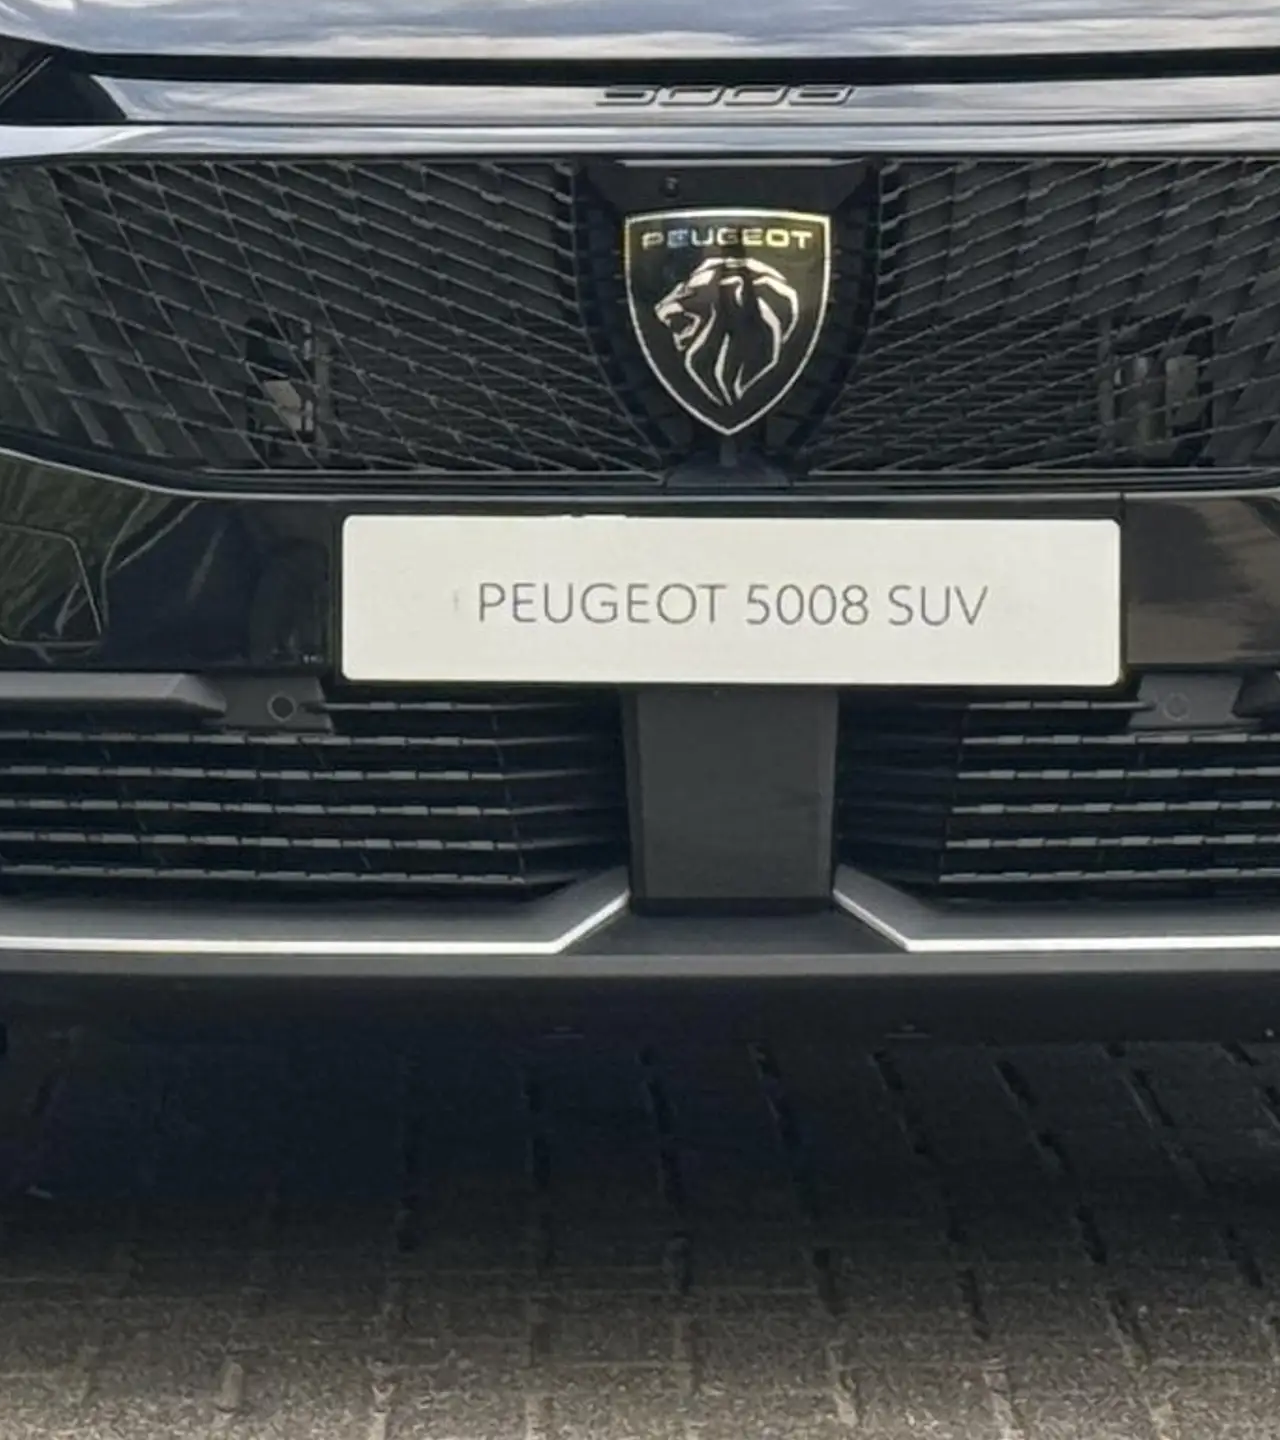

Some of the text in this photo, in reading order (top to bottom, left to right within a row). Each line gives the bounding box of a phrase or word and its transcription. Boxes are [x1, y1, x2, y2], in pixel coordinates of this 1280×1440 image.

[641, 227, 813, 250] PEUGEOT
[477, 582, 988, 626] PEUGEOT 5008 SUV
